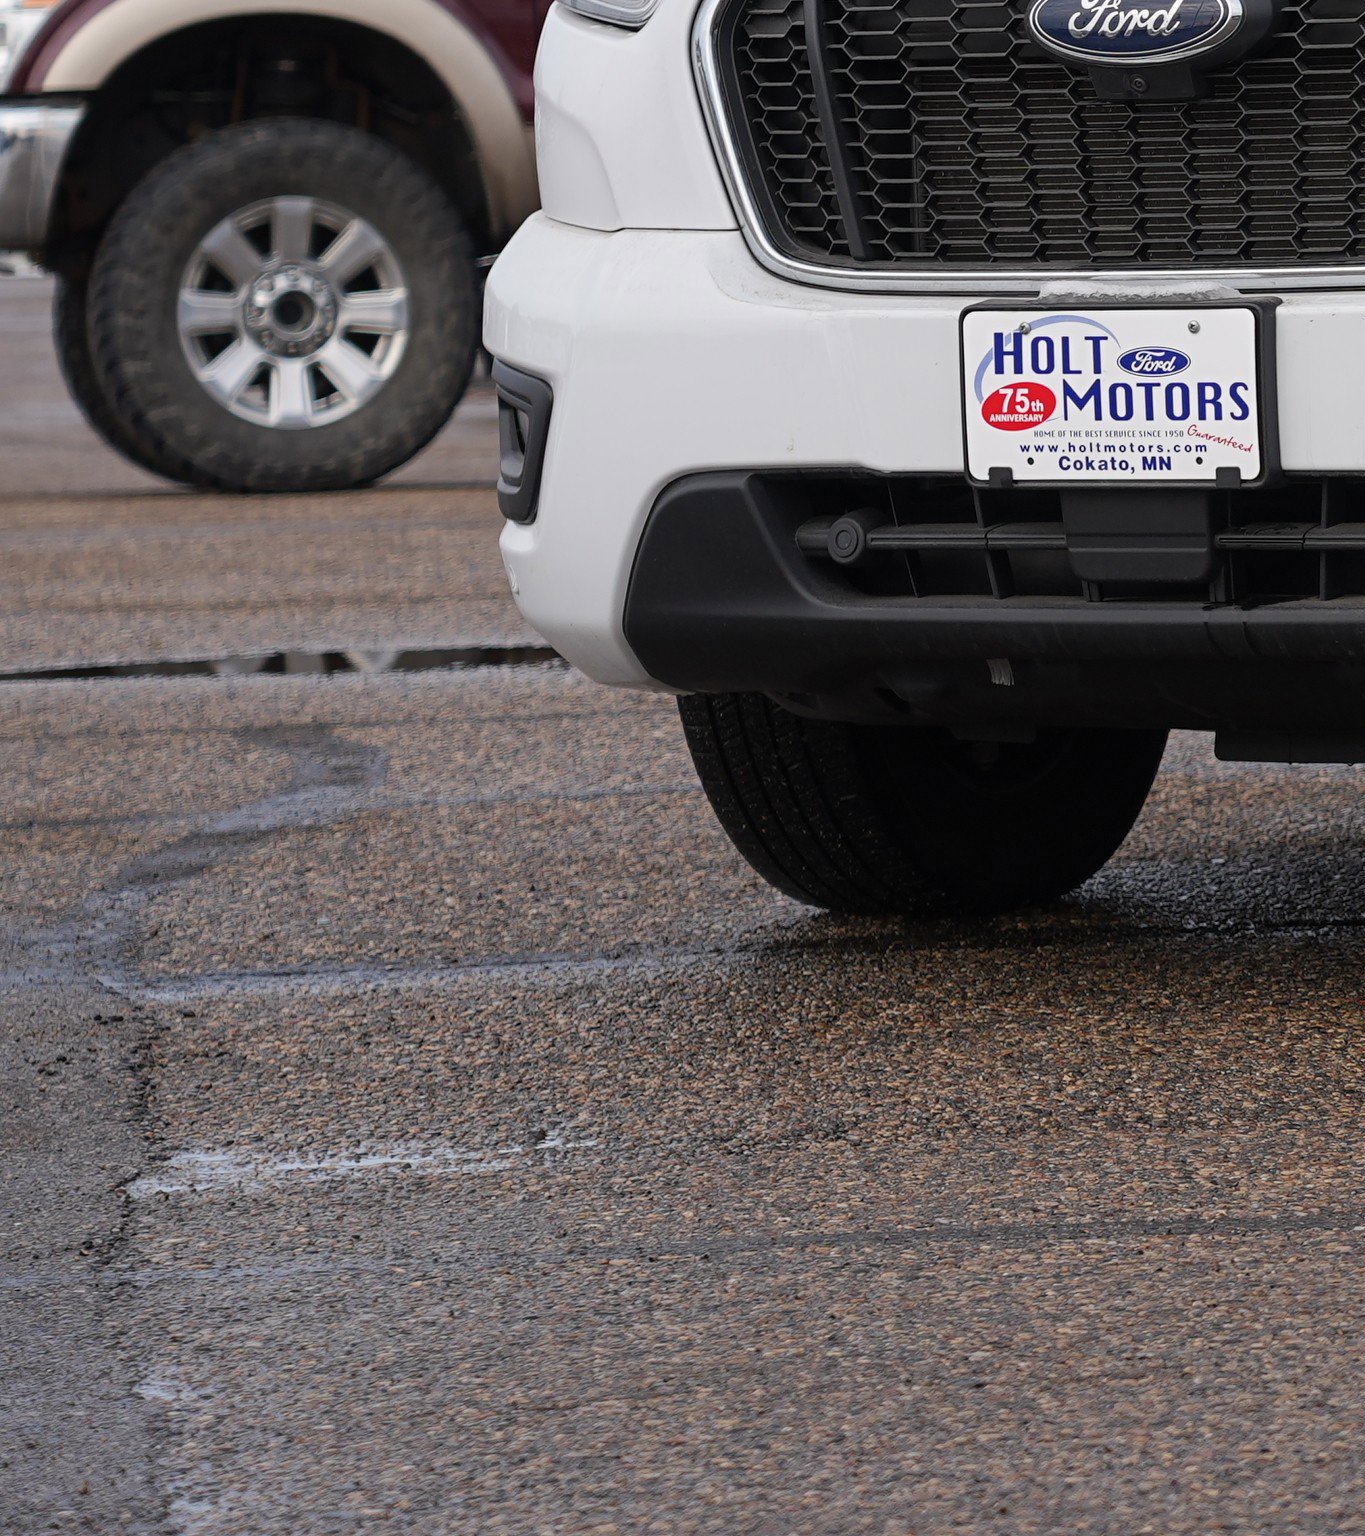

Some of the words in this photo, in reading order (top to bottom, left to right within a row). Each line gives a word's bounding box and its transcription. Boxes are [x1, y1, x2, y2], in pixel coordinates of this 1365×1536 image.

[993, 332, 1108, 375] HOLT
[1131, 350, 1177, 372] Ford
[998, 388, 1045, 413] 75th
[1062, 378, 1250, 421] MOTORS
[989, 414, 1044, 423] ANNIVERSARY
[1033, 430, 1055, 438] HOME
[1058, 430, 1066, 438] OF
[1069, 430, 1082, 438] THE
[1085, 430, 1103, 438] BEST
[1105, 430, 1136, 438] SERVICE
[1139, 430, 1161, 438] SINCE
[1165, 430, 1184, 438] 1950
[1187, 424, 1254, 453] Guaranteed
[1020, 442, 1207, 453] www.holtmotors.com
[1058, 455, 1135, 474] Cokato,
[1142, 455, 1172, 471] MN
